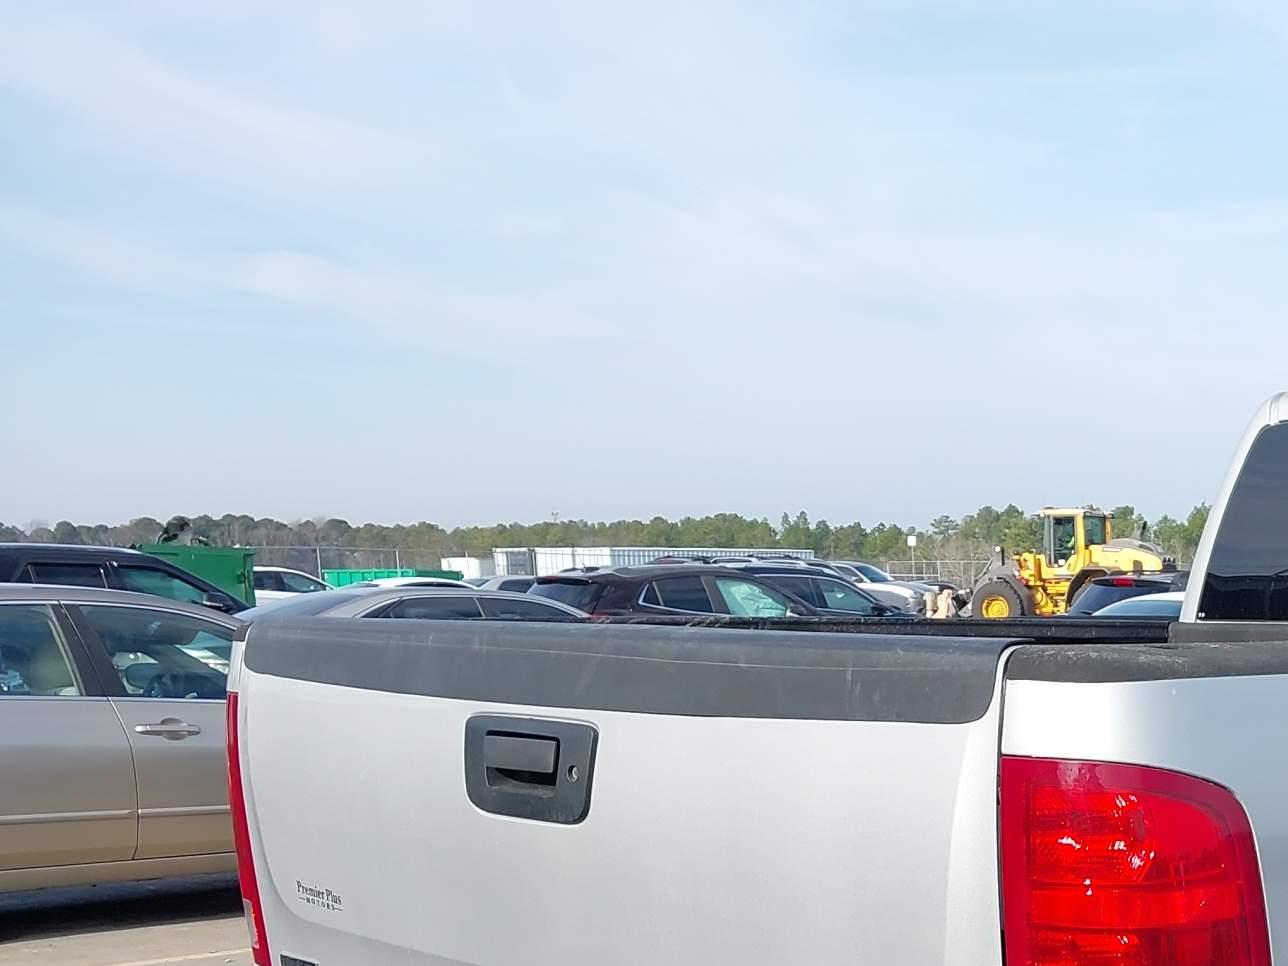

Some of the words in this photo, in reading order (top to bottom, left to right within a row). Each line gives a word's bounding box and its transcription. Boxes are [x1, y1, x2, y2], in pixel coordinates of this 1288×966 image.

[296, 880, 325, 900] Premier
[325, 888, 342, 906] Plus
[305, 896, 335, 911] MOTORS
